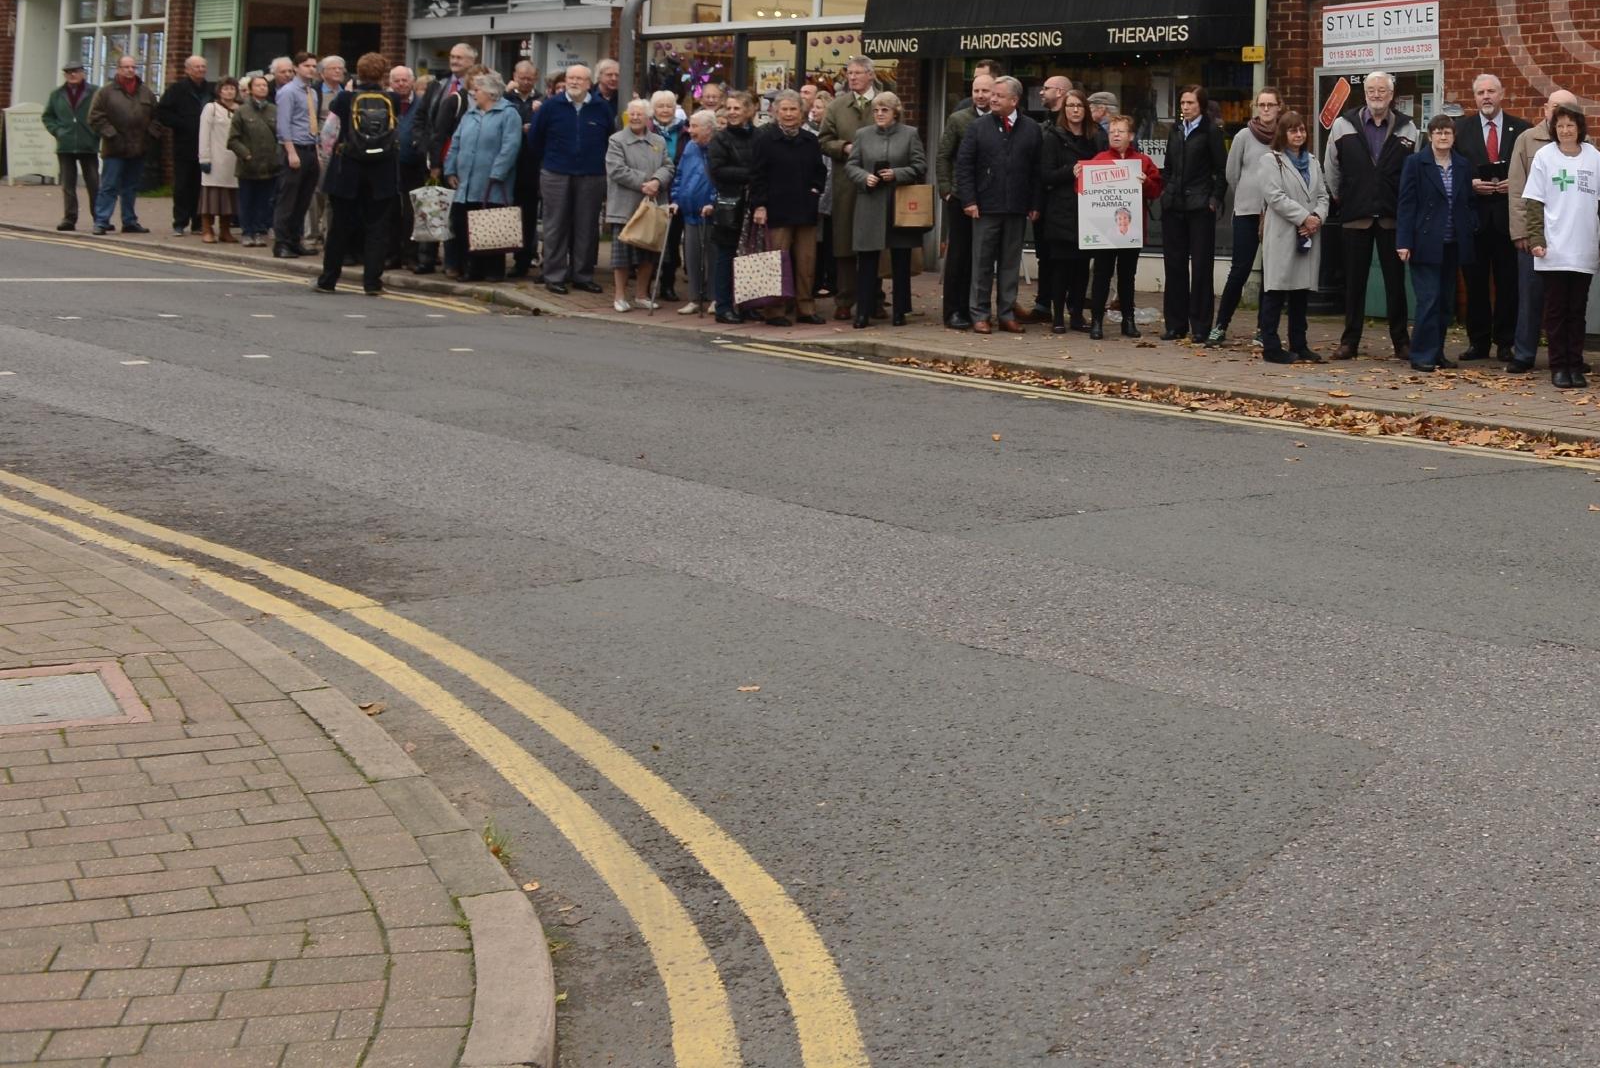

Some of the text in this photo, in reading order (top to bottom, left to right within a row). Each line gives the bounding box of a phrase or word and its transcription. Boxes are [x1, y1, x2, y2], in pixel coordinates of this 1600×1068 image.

[1327, 12, 1375, 31] STYLE
[1383, 7, 1434, 26] STYLE
[863, 25, 1189, 53] TANNING HAIRDRESSING THERAPIES
[1345, 49, 1357, 58] 934
[1386, 43, 1432, 55] 0118 934 3738
[1095, 168, 1127, 182] ACT NOW
[1083, 188, 1116, 196] SUPPORT
